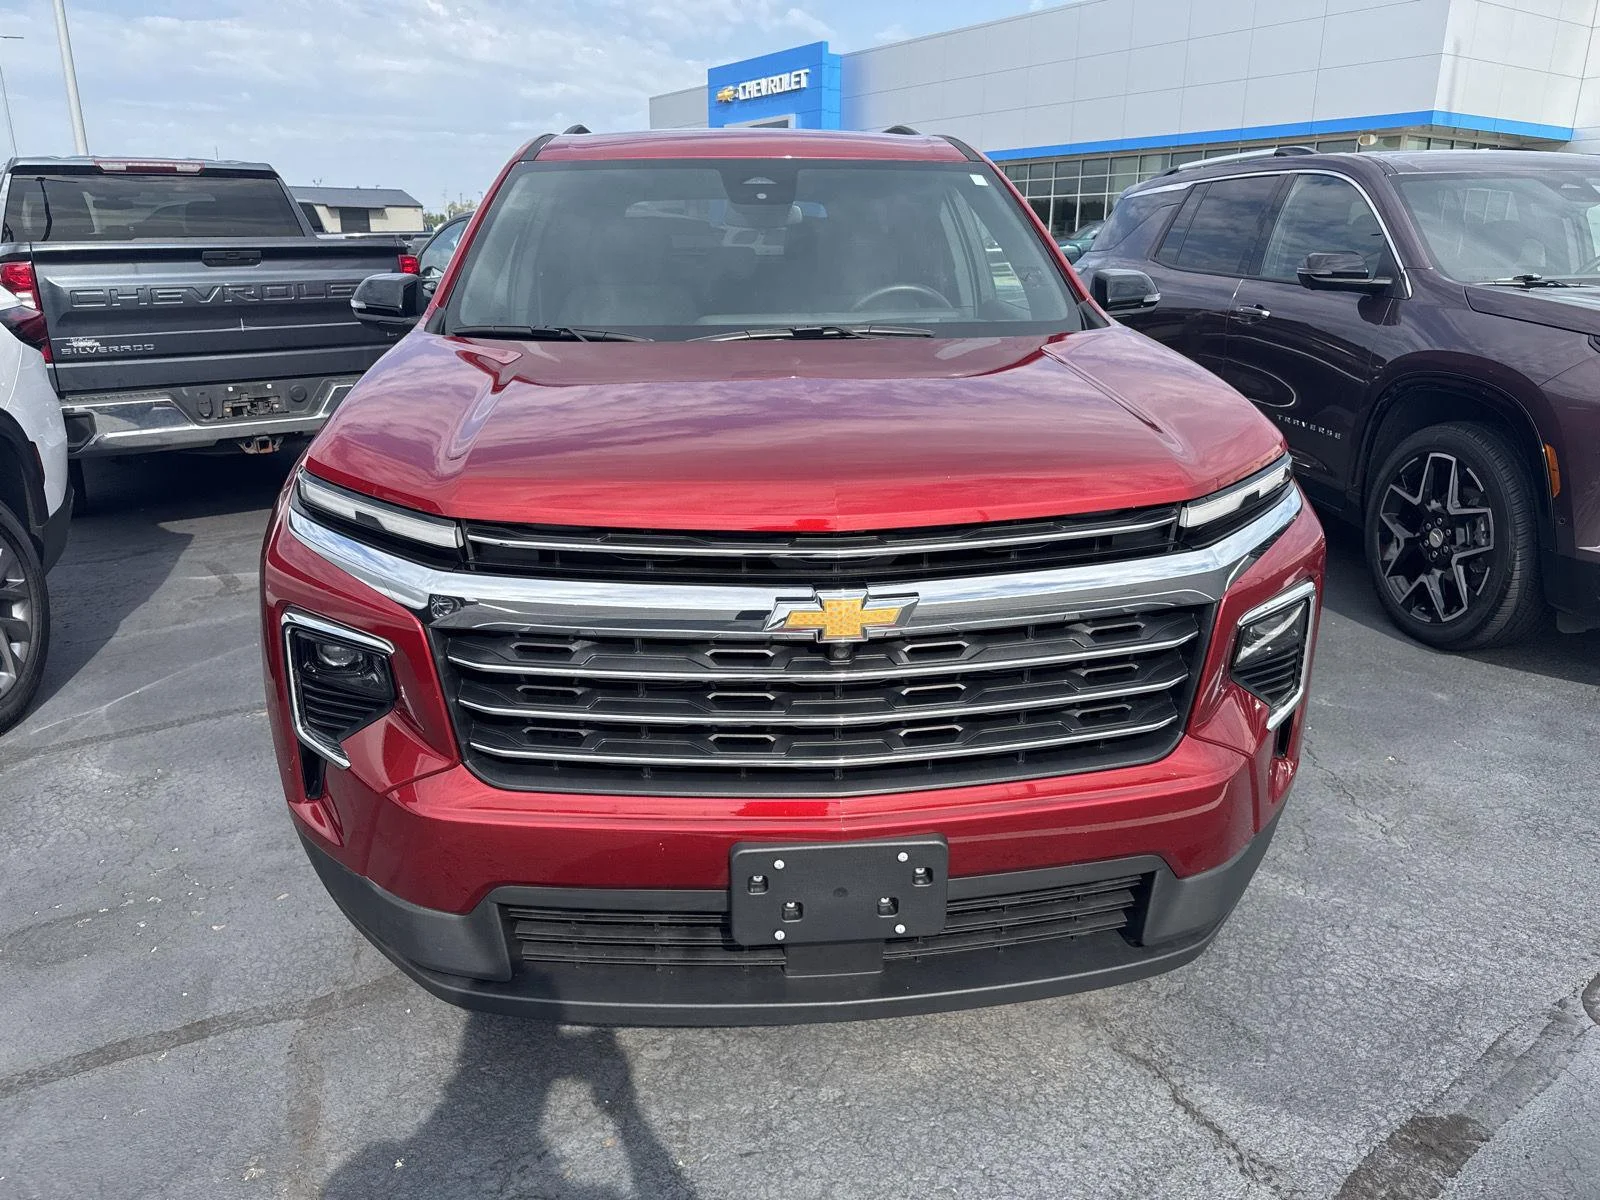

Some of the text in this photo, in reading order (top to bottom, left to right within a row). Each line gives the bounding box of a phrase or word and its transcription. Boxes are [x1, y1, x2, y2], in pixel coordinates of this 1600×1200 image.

[738, 68, 811, 100] CHEVROLET
[69, 280, 359, 308] CHEVROLE
[60, 343, 155, 355] SILVERADO
[1276, 413, 1342, 440] TRAVERSE
